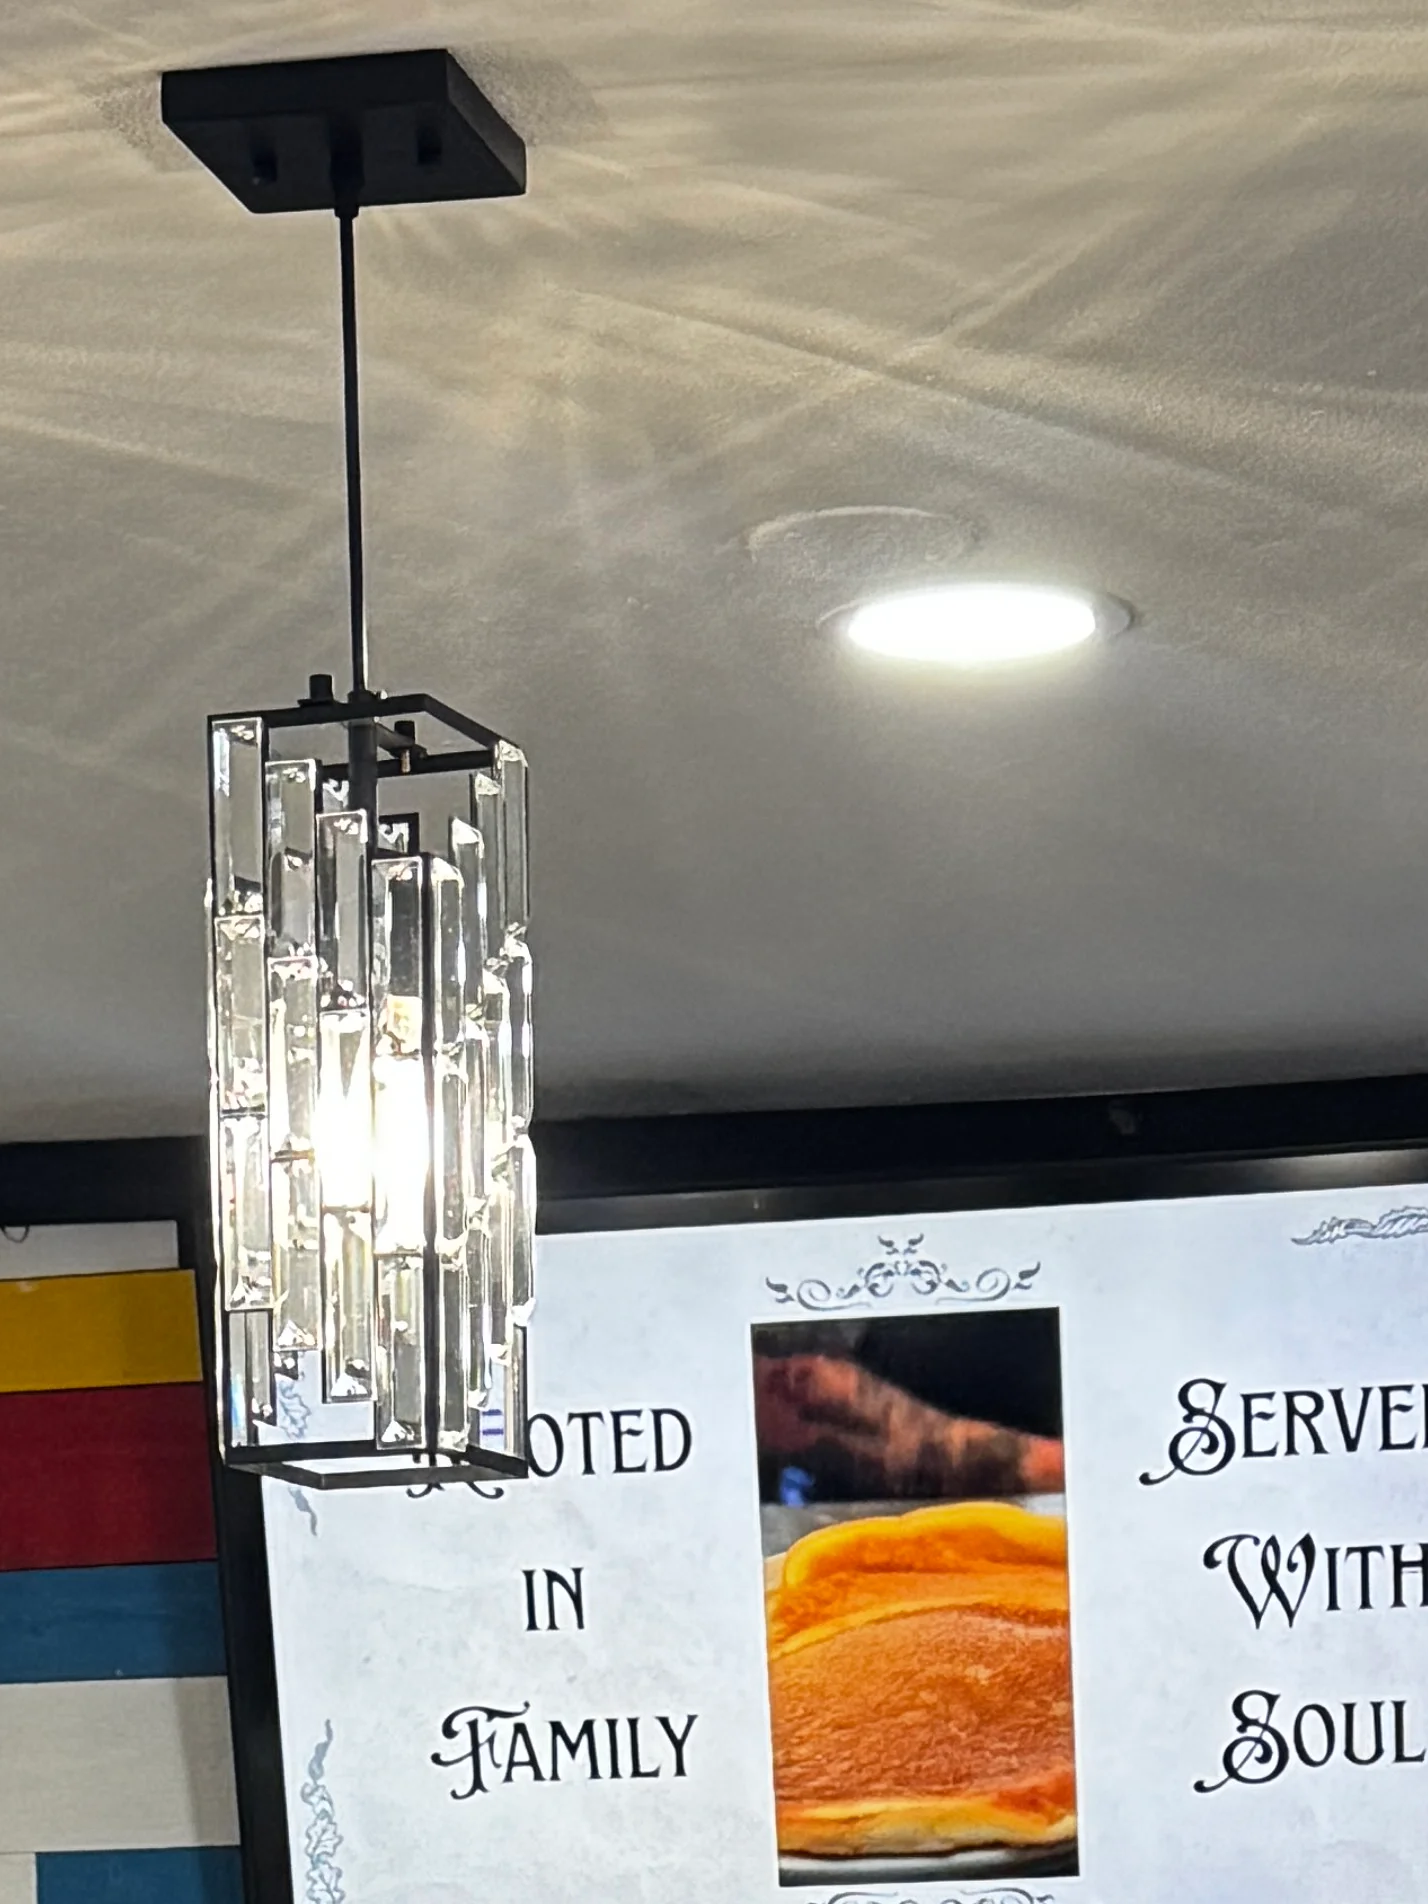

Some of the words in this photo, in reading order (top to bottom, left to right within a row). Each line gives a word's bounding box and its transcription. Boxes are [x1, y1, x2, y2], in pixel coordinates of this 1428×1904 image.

[406, 1408, 693, 1499] OTED
[522, 1567, 585, 1632] IN
[430, 1701, 698, 1800] FAMILY
[1193, 1689, 1427, 1793] SOUL
